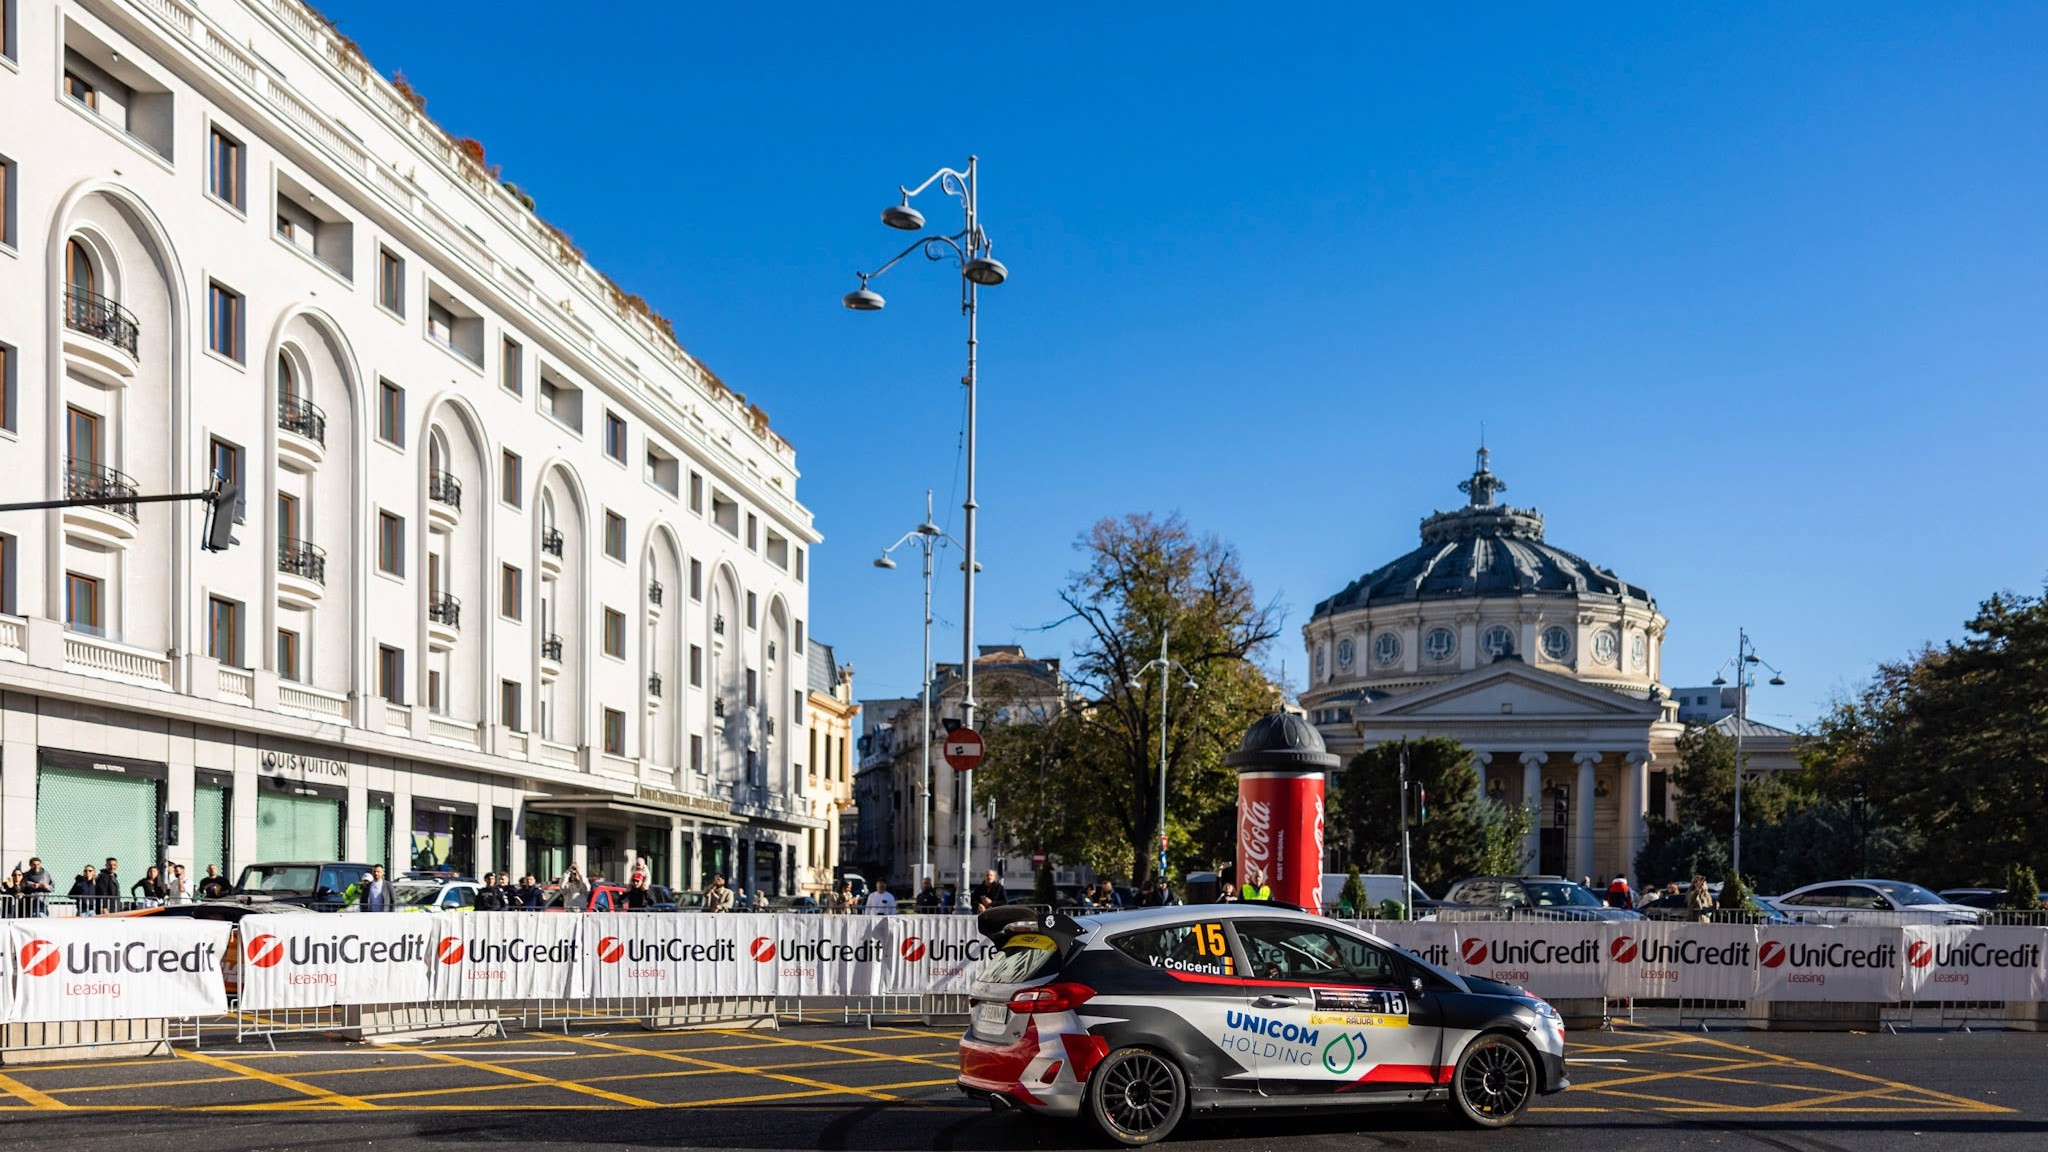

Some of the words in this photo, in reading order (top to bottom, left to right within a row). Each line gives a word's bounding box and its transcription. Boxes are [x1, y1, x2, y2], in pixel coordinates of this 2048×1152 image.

[262, 751, 297, 769] LOUIS
[301, 756, 347, 778] VUITTON
[289, 934, 424, 965] UniCredit
[469, 937, 577, 965] UniCredit
[628, 937, 735, 963] UniCredit
[780, 938, 883, 963] UniCredit
[929, 939, 1000, 962] UniCre
[1192, 923, 1226, 956] 15
[1491, 938, 1600, 965] UniCredit
[67, 941, 216, 976] UniCredit
[1641, 939, 1749, 966] UniCredit
[1789, 942, 1895, 968] UniCredit
[1935, 942, 2039, 968] UniCredit
[468, 968, 507, 981] Leasing
[628, 966, 665, 980] Leasing
[780, 967, 815, 979] Leasing
[928, 966, 964, 978] Leasing
[1149, 955, 1161, 967] V.
[1164, 957, 1220, 975] Colceriu
[1491, 969, 1529, 982] Leasing
[1640, 968, 1679, 983] Leasing
[66, 981, 121, 999] Leasing
[289, 972, 338, 987] Leasing
[1788, 972, 1825, 986] Leasing
[1934, 972, 1969, 986] Leasing
[1381, 992, 1404, 1014] 15
[1226, 1010, 1319, 1047] UNICOM
[1221, 1033, 1313, 1066] HOLDING
